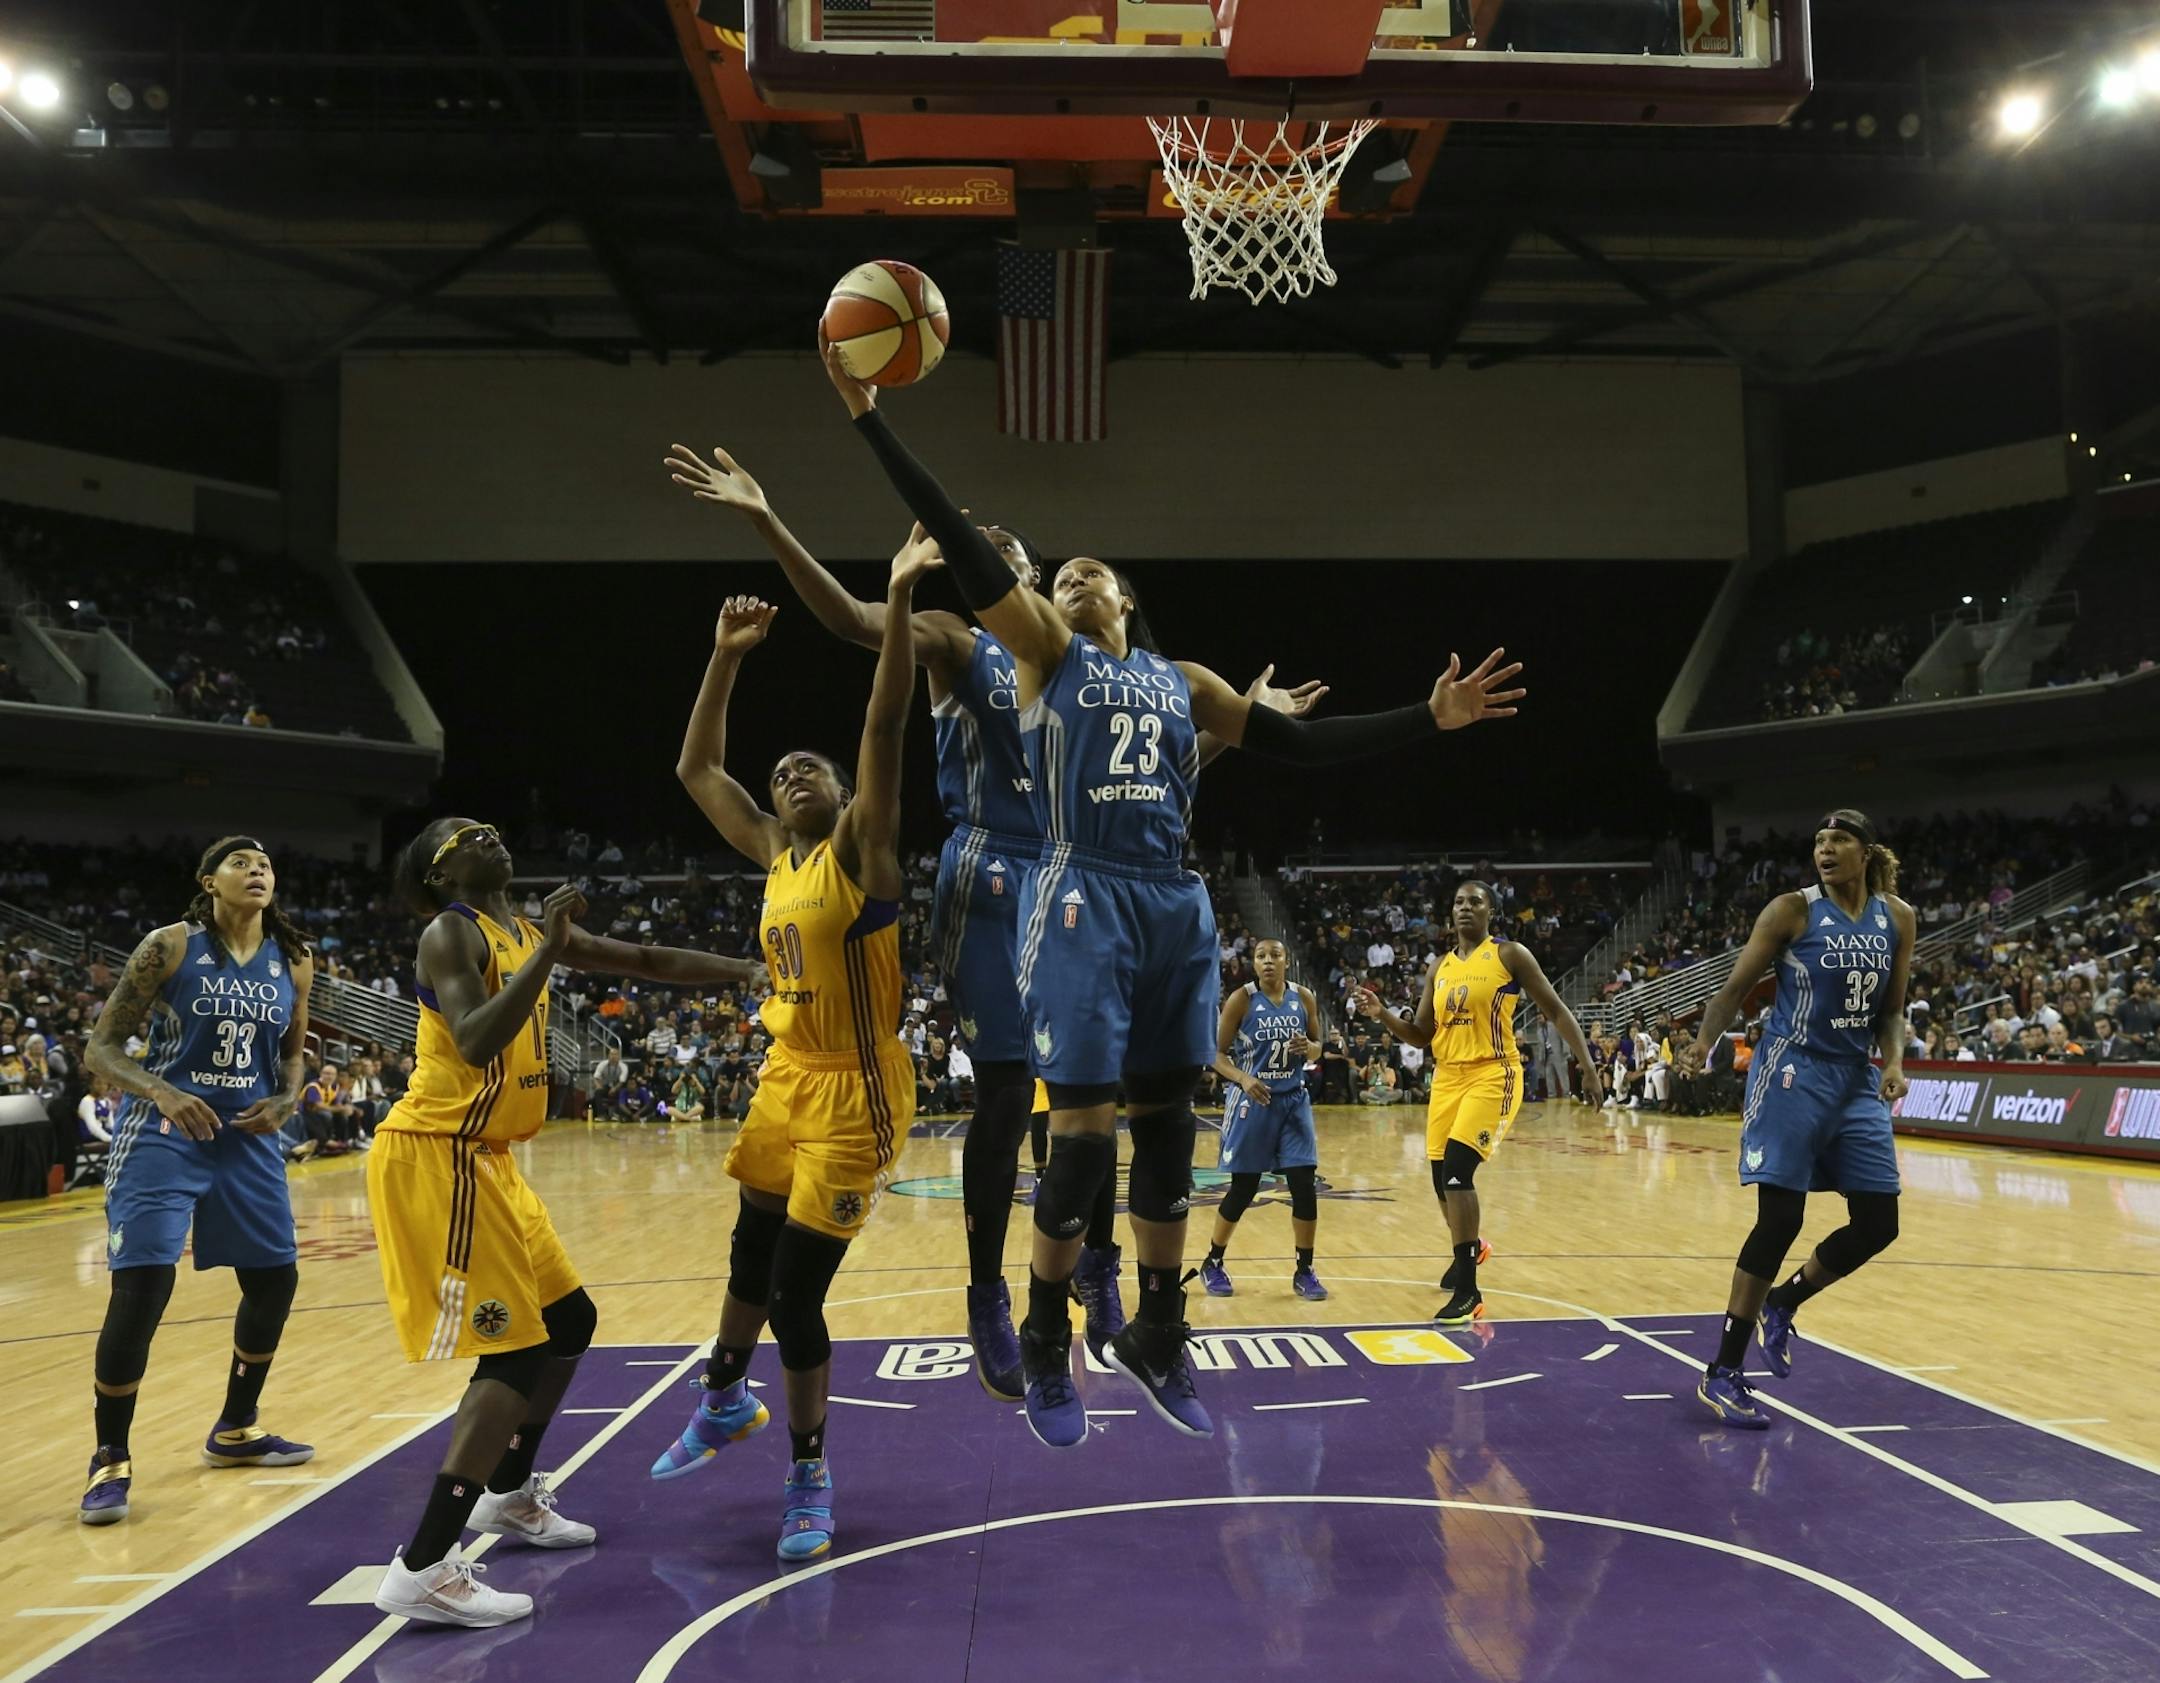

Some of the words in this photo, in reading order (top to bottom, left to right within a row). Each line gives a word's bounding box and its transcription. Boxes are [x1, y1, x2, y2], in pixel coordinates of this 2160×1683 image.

[1084, 661, 1175, 691] MAYO
[1077, 683, 1187, 719] CLINIC
[1108, 712, 1163, 776] 23
[1088, 780, 1166, 804] verizon
[767, 922, 803, 980] 30
[1824, 934, 1888, 951] MAYO
[1820, 952, 1892, 971] CLINIC
[200, 976, 278, 1002] MAYO
[1446, 985, 1469, 1013] 42
[1844, 970, 1879, 1012] 32
[192, 997, 283, 1025] CLINIC
[1257, 1015, 1300, 1029] MAYO
[212, 1020, 257, 1069] 33
[1268, 1040, 1290, 1069] 21
[191, 1071, 256, 1089] verizon
[1992, 1089, 2067, 1125] verizon
